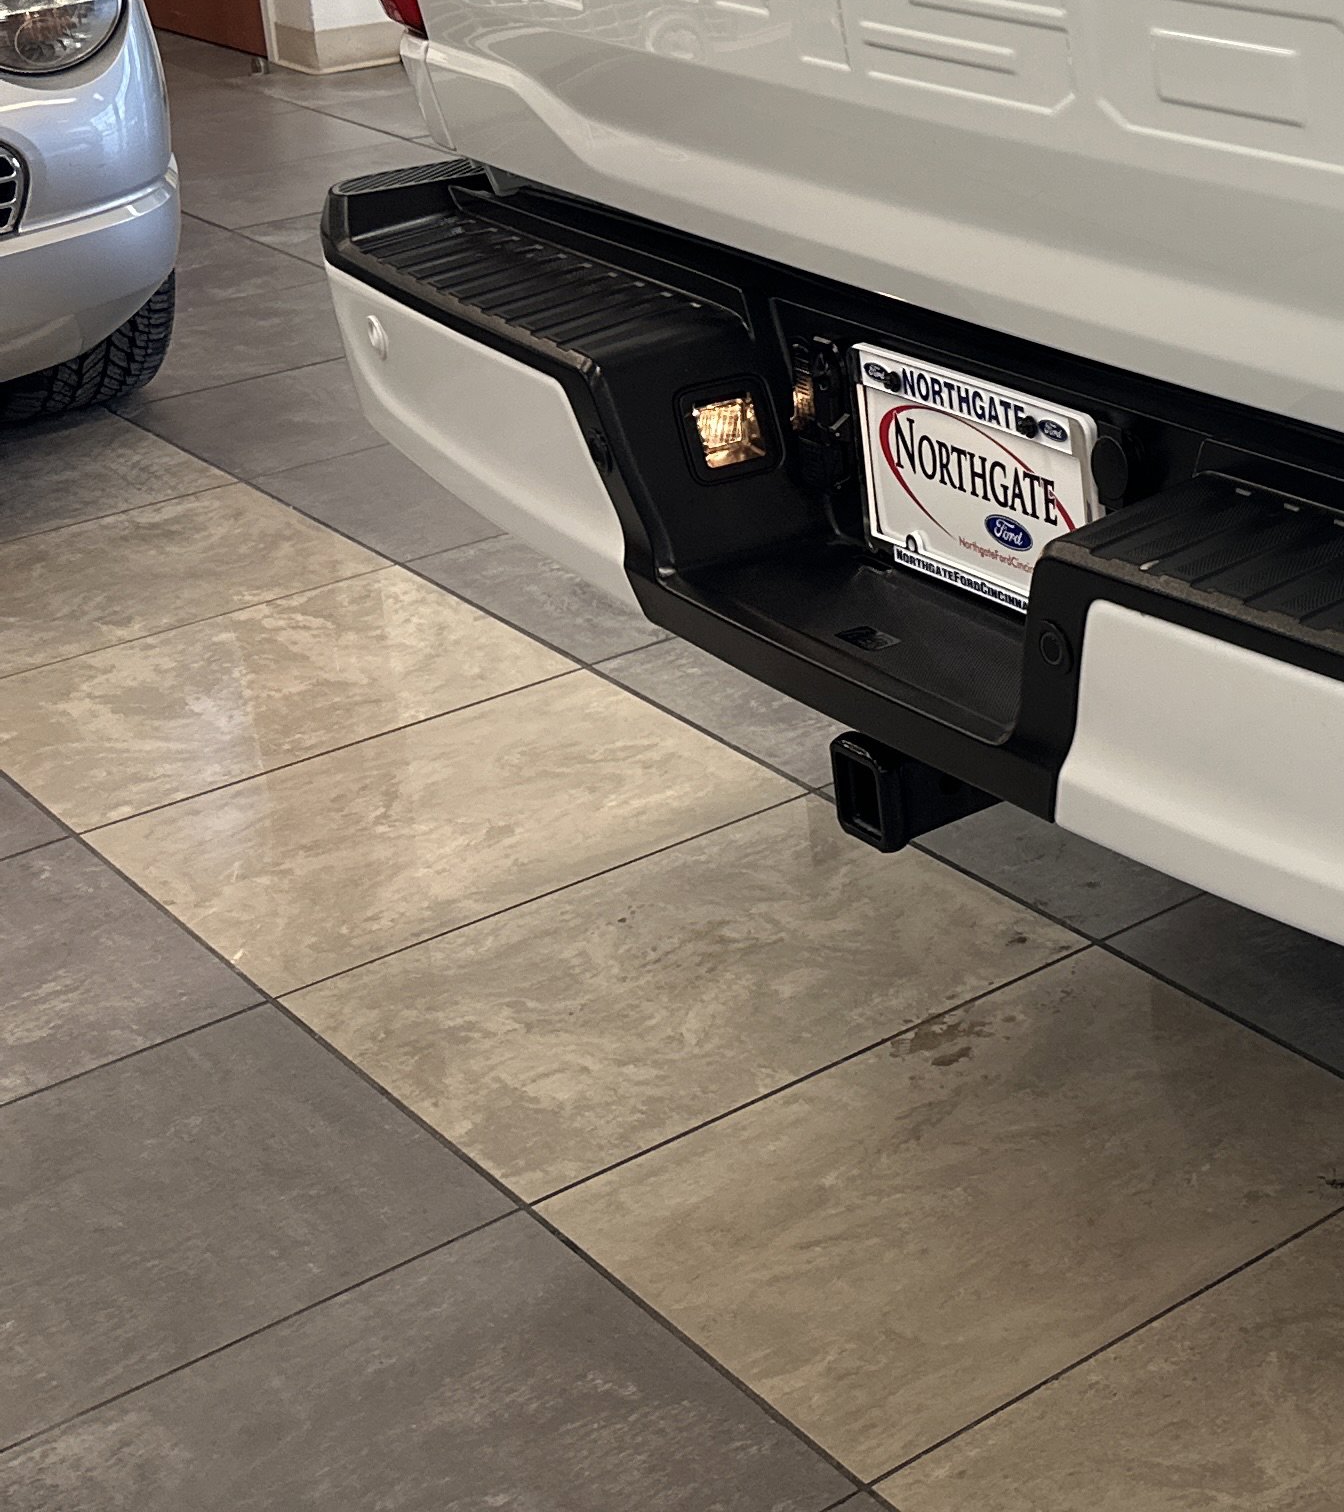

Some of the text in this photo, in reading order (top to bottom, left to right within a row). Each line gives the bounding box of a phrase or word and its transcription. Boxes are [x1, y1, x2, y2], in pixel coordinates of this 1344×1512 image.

[901, 367, 1025, 433] NORTHGATE
[894, 413, 1058, 526] NORTHGATE
[994, 518, 1024, 546] Ford
